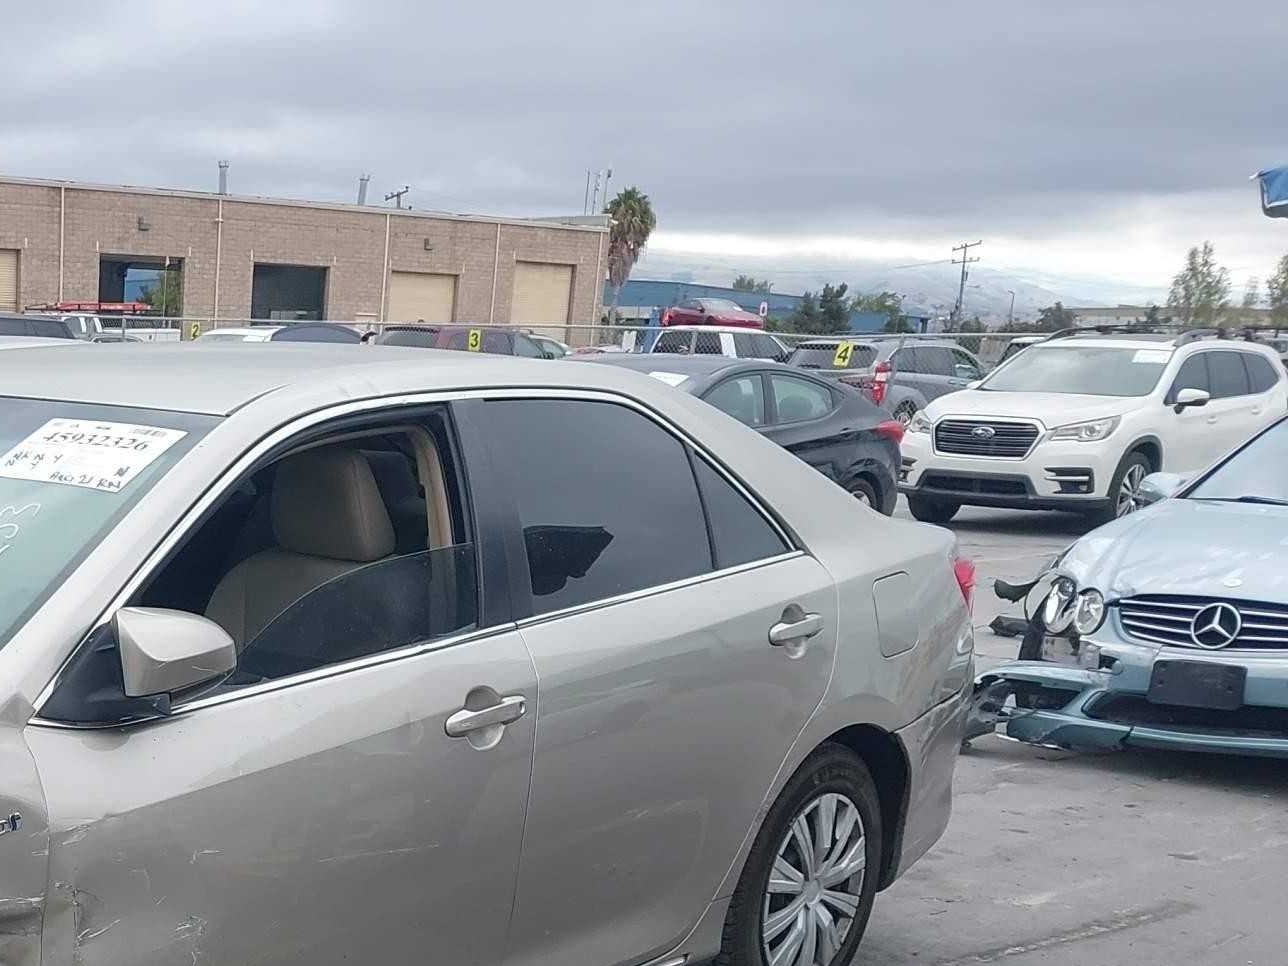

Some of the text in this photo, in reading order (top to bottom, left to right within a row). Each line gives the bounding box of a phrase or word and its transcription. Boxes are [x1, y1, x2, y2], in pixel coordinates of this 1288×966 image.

[471, 332, 479, 348] 3
[837, 345, 850, 362] 4
[43, 431, 152, 451] 45932326
